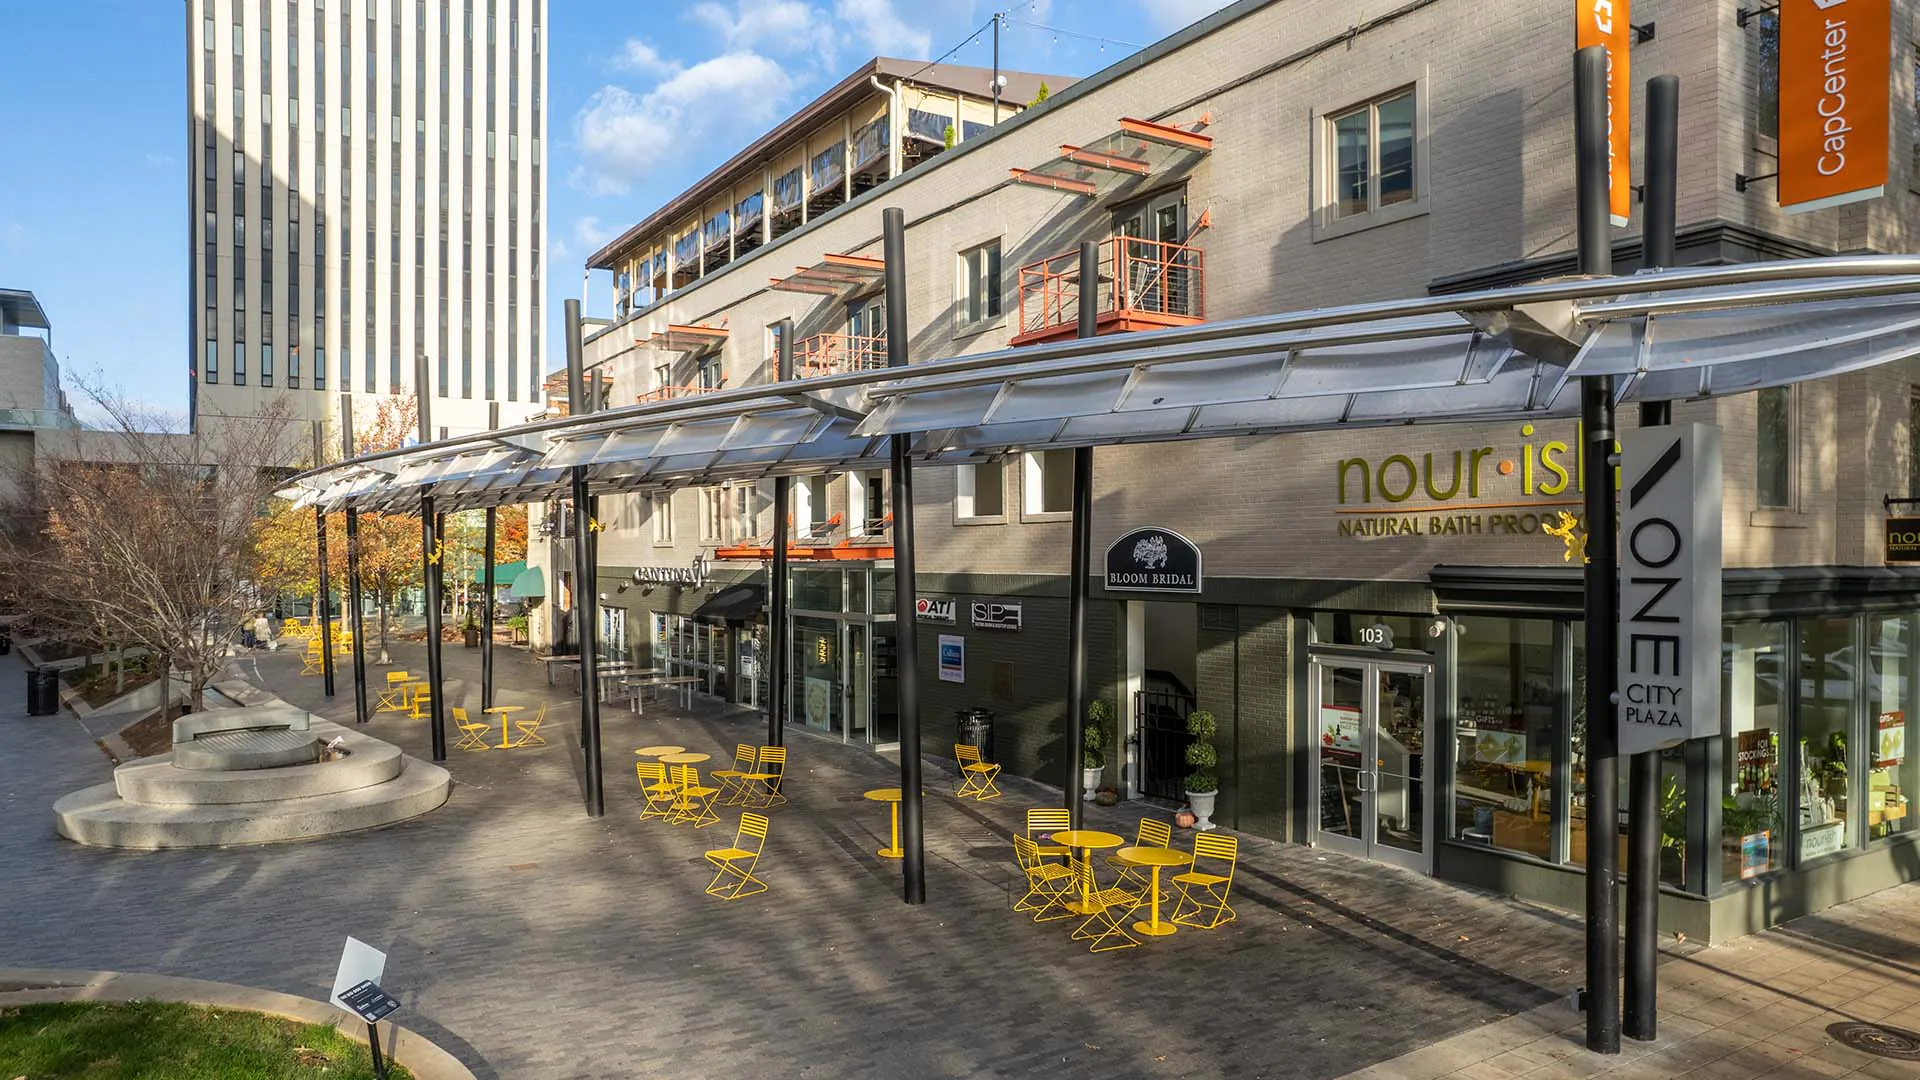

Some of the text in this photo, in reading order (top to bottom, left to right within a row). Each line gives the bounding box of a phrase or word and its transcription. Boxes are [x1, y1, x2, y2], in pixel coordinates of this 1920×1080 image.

[1817, 19, 1852, 177] CapCenter
[1338, 514, 1423, 538] NATURAL
[1429, 513, 1481, 536] BATH
[1110, 572, 1194, 586] BLOOM BRIDAL
[927, 600, 952, 615] ATI
[1359, 628, 1384, 644] 103
[1626, 683, 1683, 705] CITY
[1626, 707, 1683, 727] PLAZA
[1757, 739, 1769, 749] FOR
